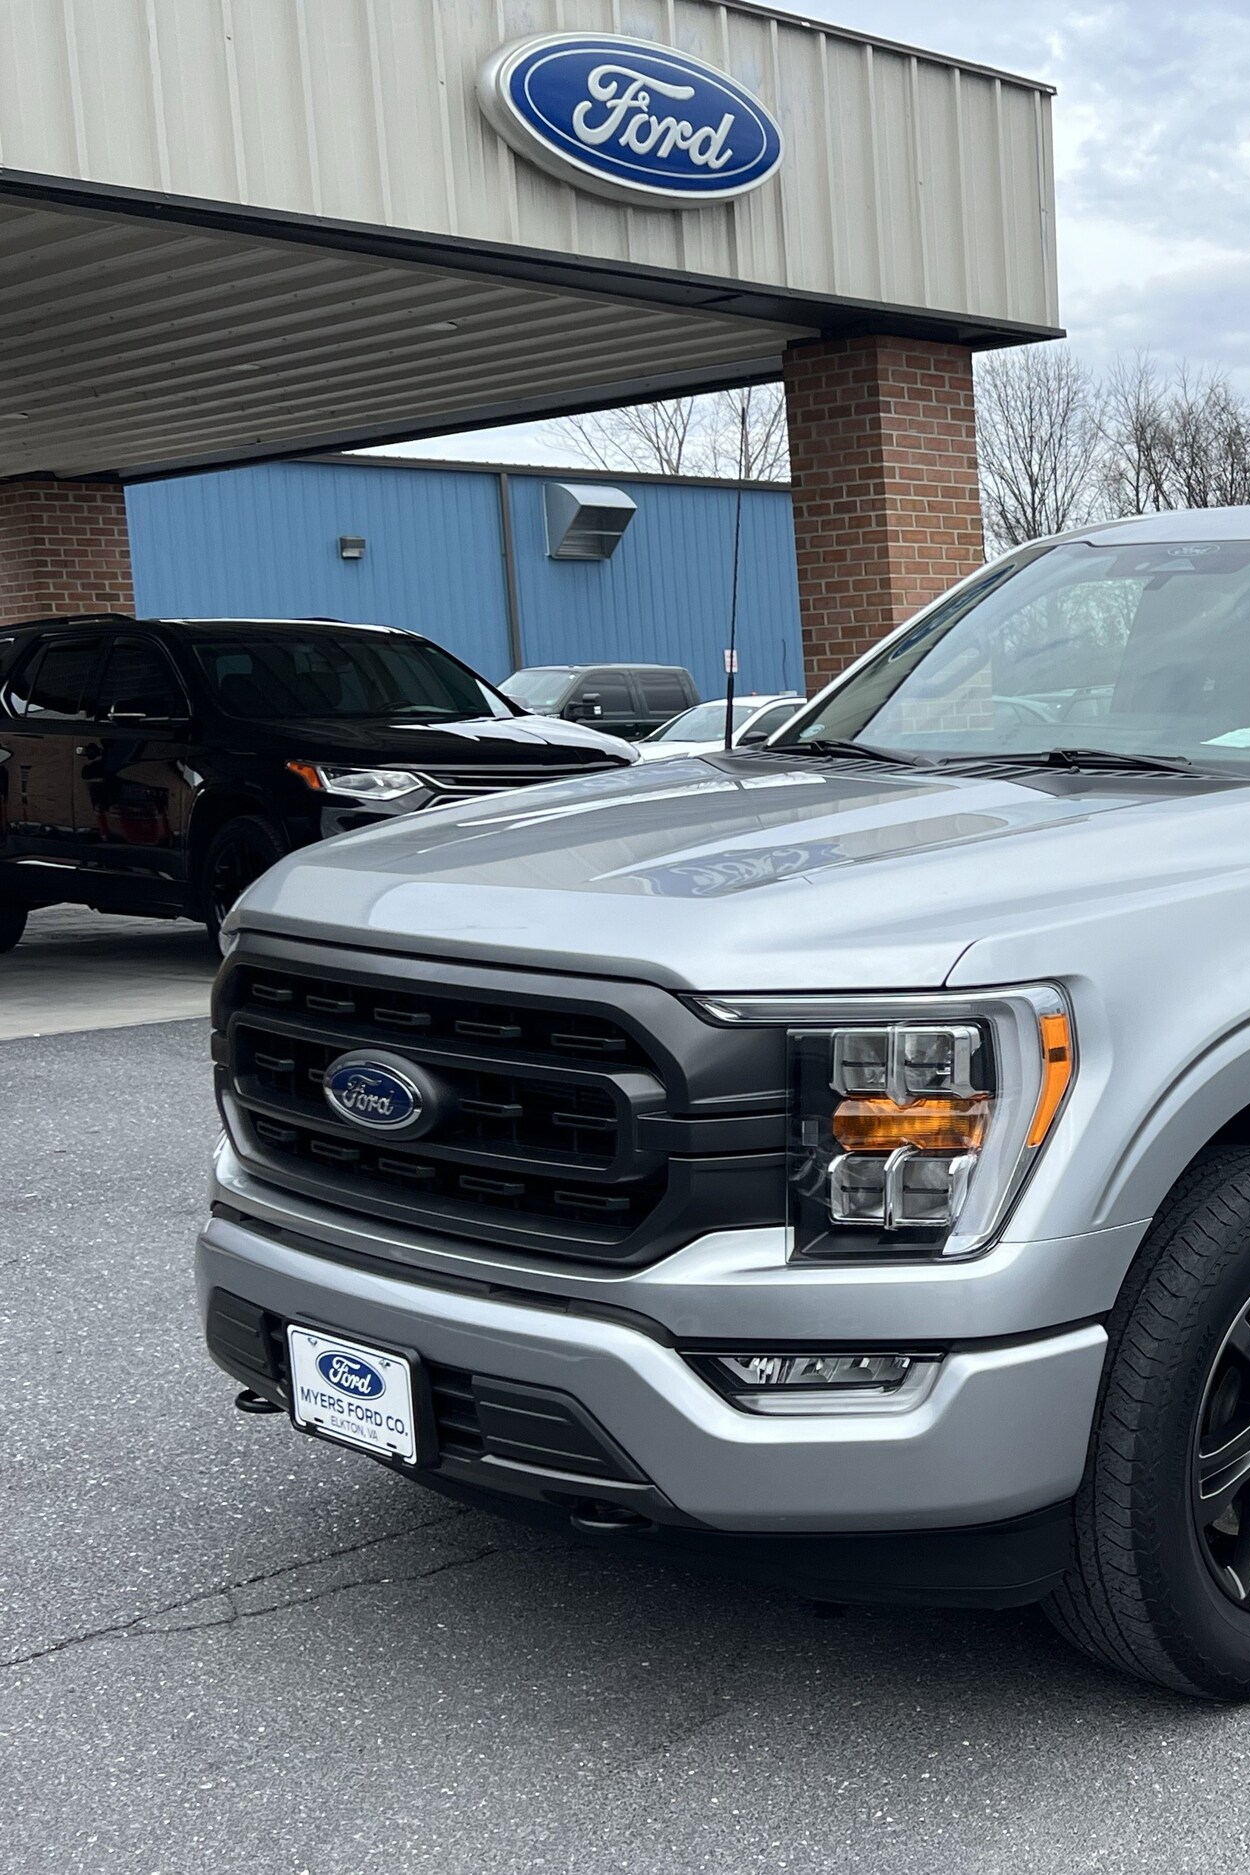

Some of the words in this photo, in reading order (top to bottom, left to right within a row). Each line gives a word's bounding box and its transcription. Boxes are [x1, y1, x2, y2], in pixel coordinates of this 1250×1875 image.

[573, 64, 735, 169] Ford
[341, 1073, 394, 1115] Ford
[329, 1356, 372, 1394] Ford
[300, 1386, 345, 1414] MYERS
[347, 1402, 383, 1427] FORD
[386, 1415, 408, 1437] CO.
[330, 1415, 366, 1438] ELKTON,
[367, 1429, 379, 1440] VA
